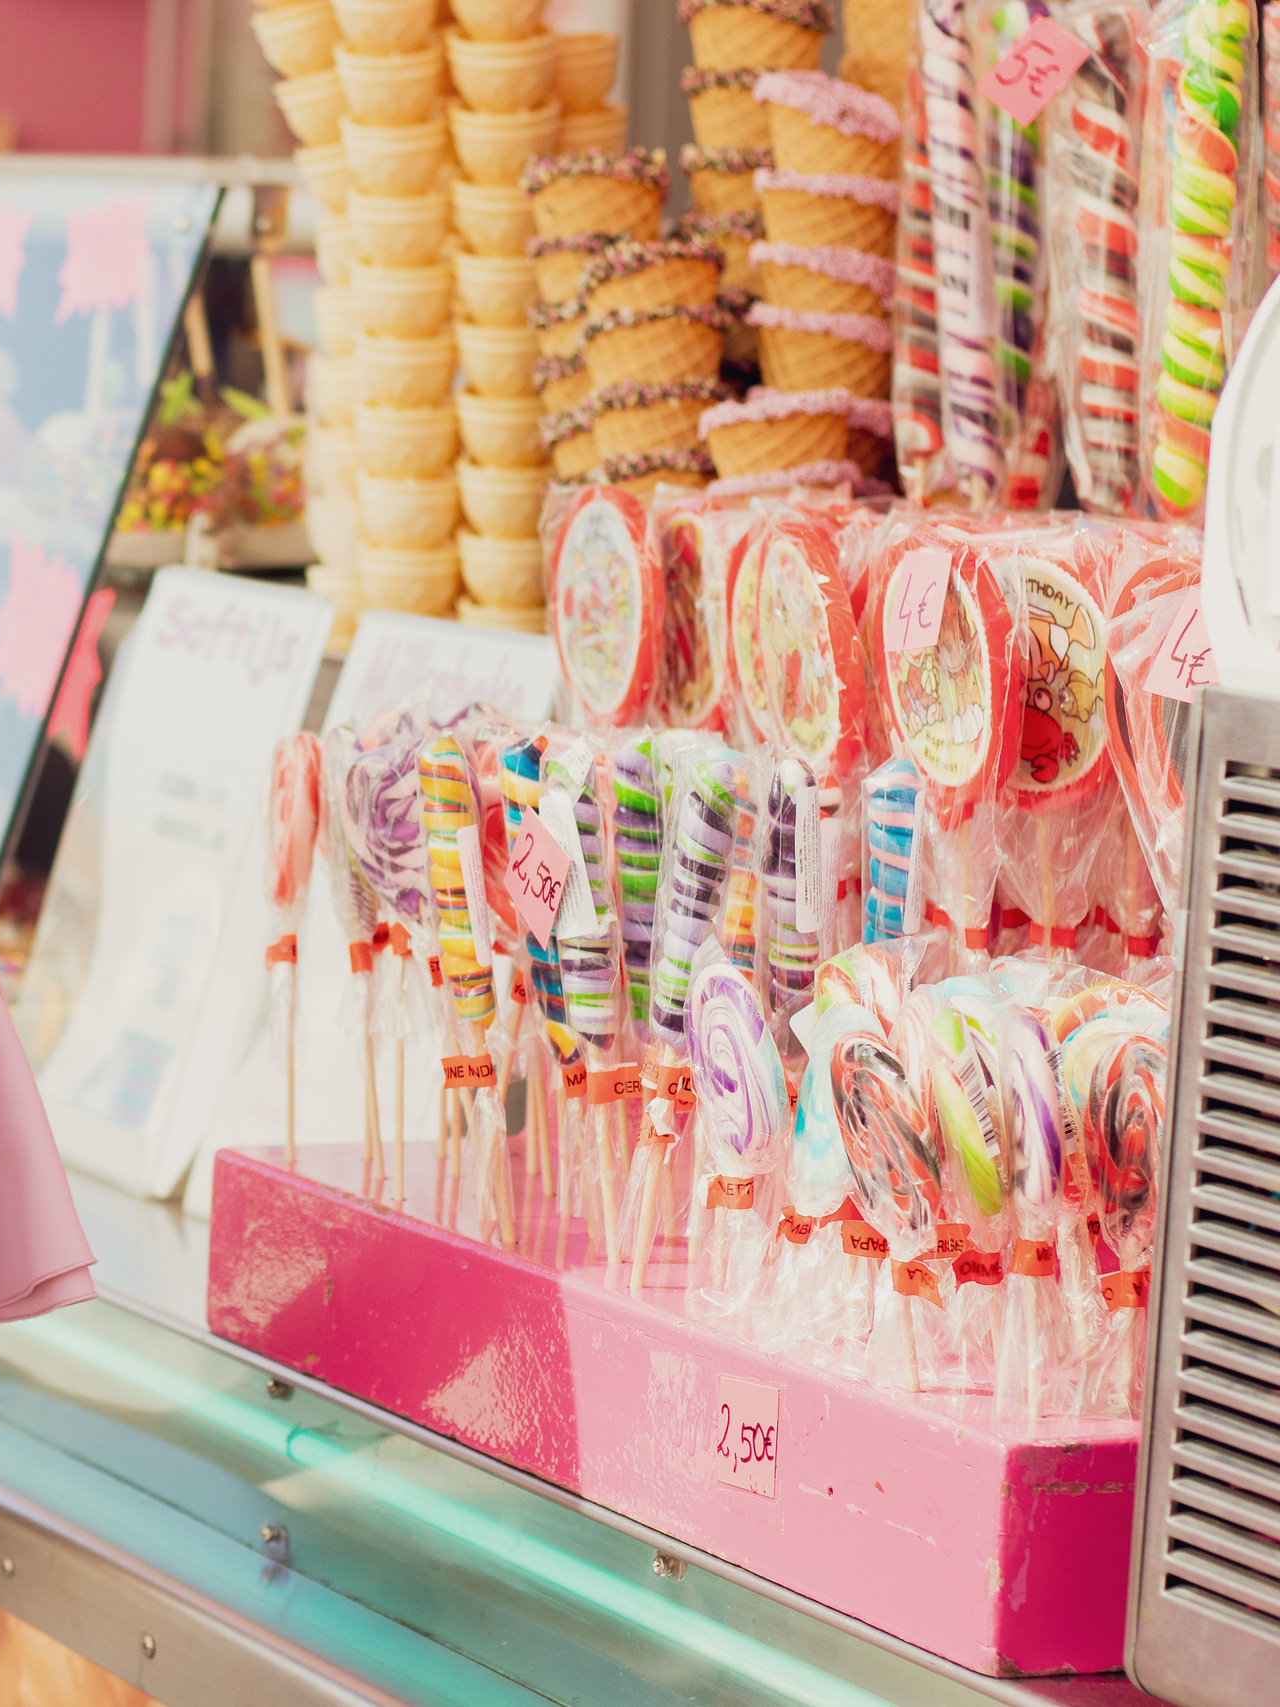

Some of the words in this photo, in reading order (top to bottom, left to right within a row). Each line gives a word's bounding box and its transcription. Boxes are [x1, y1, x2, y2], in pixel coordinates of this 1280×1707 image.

[995, 40, 1060, 98] 5€
[898, 572, 938, 648] 4€
[1170, 608, 1212, 688] 4€
[512, 832, 561, 912] 2,50€
[716, 1403, 775, 1473] 2,50€
